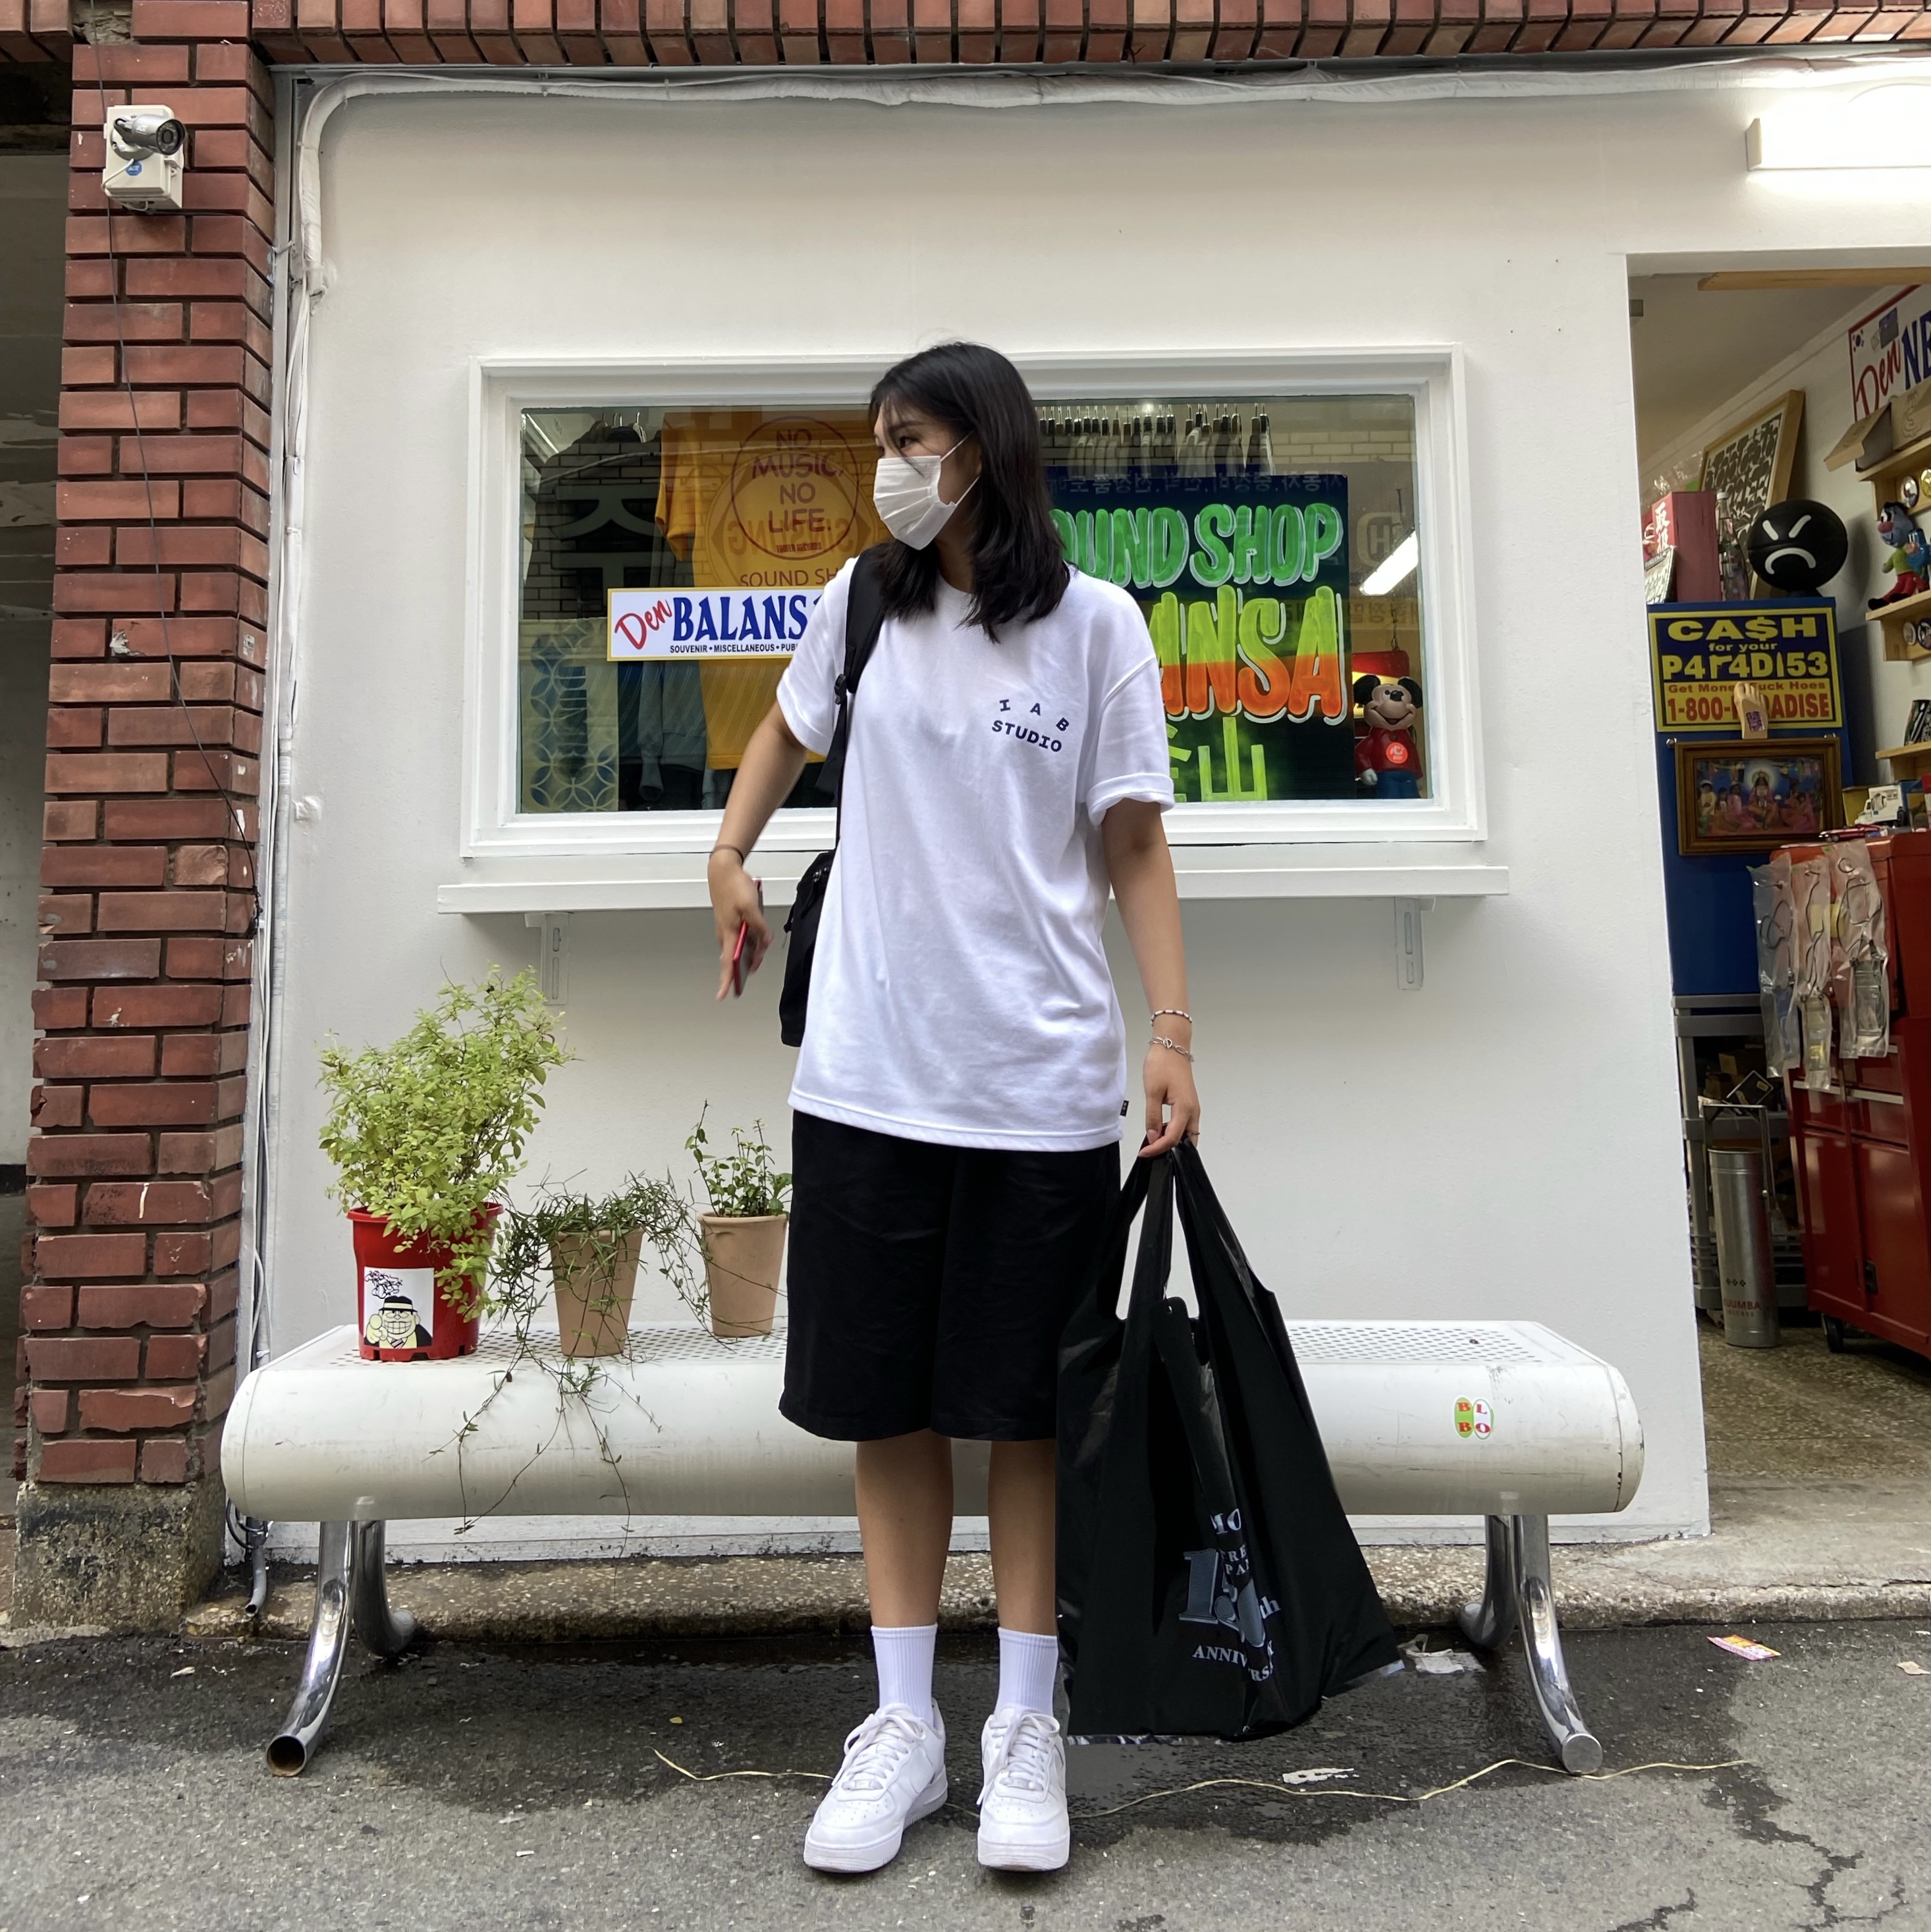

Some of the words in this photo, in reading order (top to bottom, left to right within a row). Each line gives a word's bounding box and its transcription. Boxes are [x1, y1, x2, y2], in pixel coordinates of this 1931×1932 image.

[1855, 339, 1901, 416] Den
[776, 429, 812, 451] NO
[780, 482, 815, 505] NO
[769, 509, 831, 533] LIFE.
[1189, 503, 1344, 588] SHOP
[740, 569, 809, 587] SOUND
[614, 599, 672, 650] Den
[672, 595, 822, 642] BALANS
[714, 644, 775, 652] MISCELLANEOUS
[1708, 643, 1733, 652] for
[1739, 642, 1778, 653] your
[1668, 684, 1693, 693] Get
[1699, 683, 1735, 692] Mone
[1789, 680, 1826, 689] Hoes
[991, 720, 1062, 752] STUDIO
